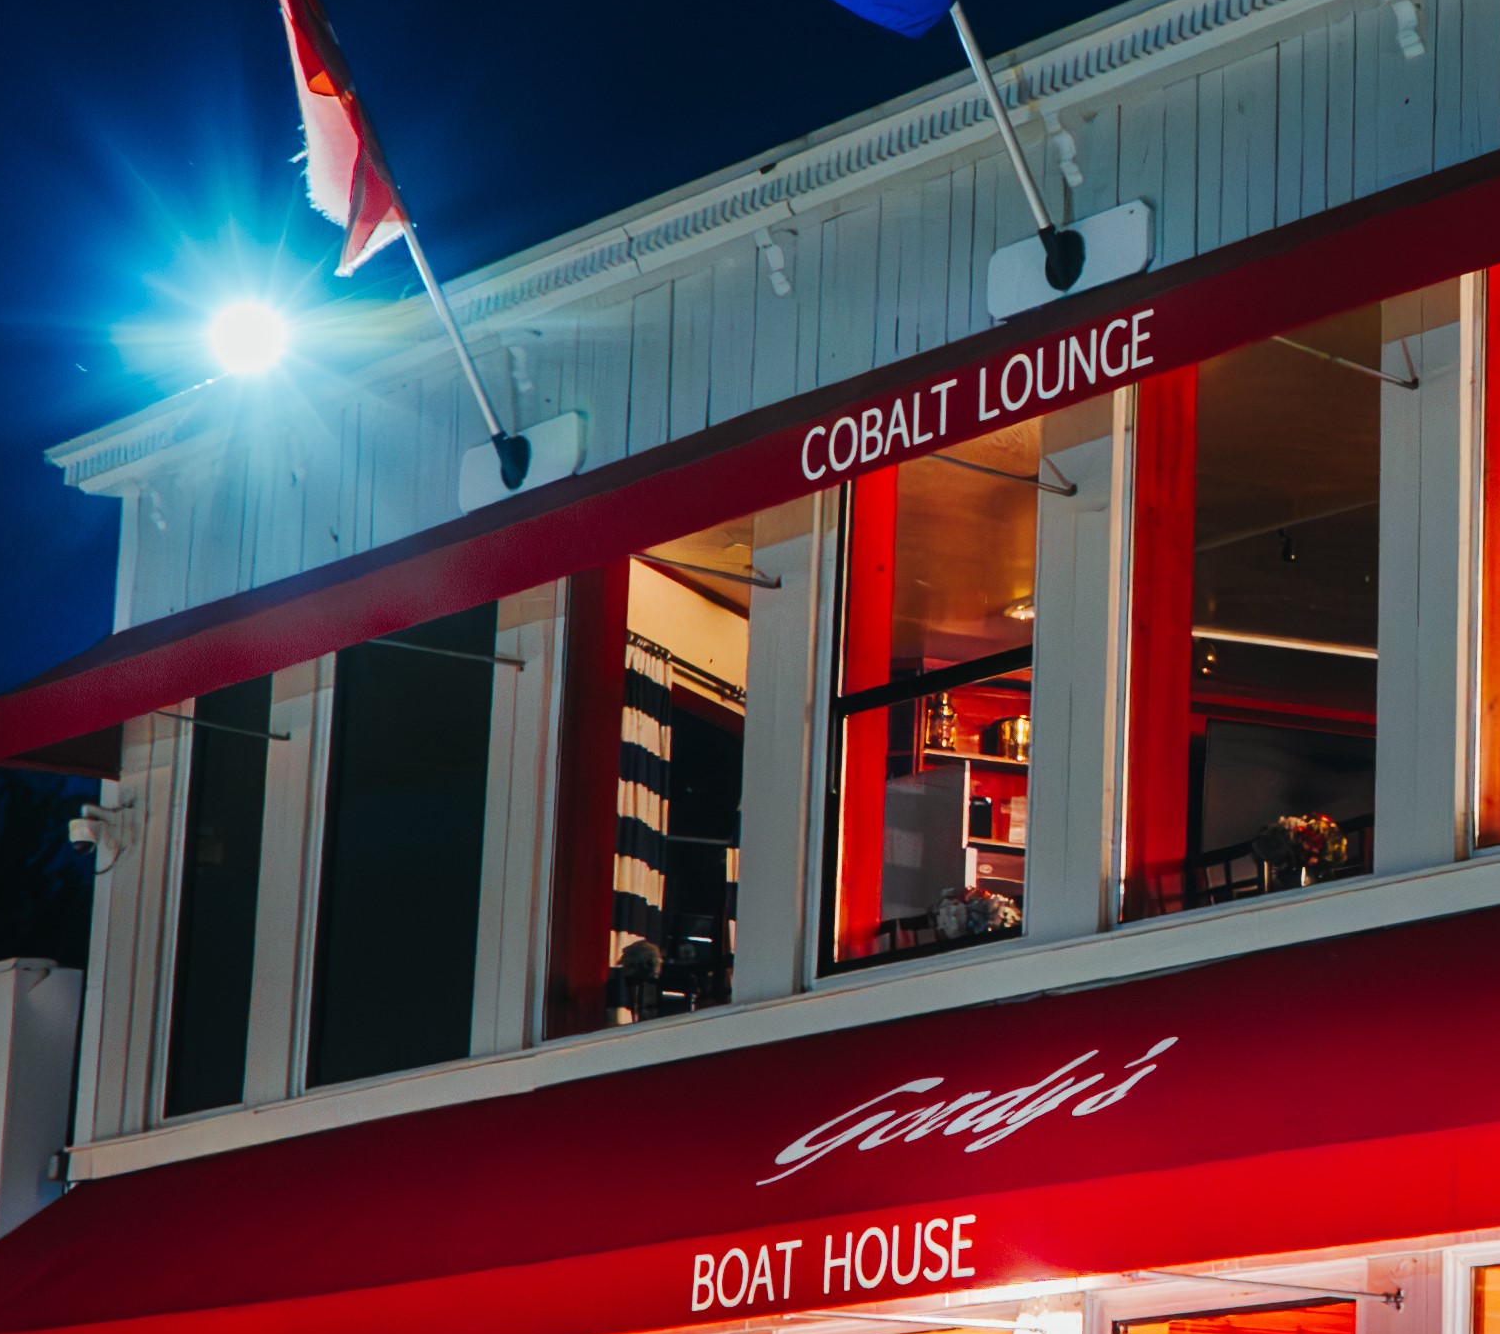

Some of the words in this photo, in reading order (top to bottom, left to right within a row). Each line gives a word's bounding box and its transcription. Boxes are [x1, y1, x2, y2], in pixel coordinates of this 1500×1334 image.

[801, 377, 958, 482] COBALT
[977, 308, 1155, 423] LOUNGE
[755, 1036, 1179, 1187] Gordy's
[690, 1238, 803, 1312] BOAT
[822, 1213, 978, 1296] HOUSE
